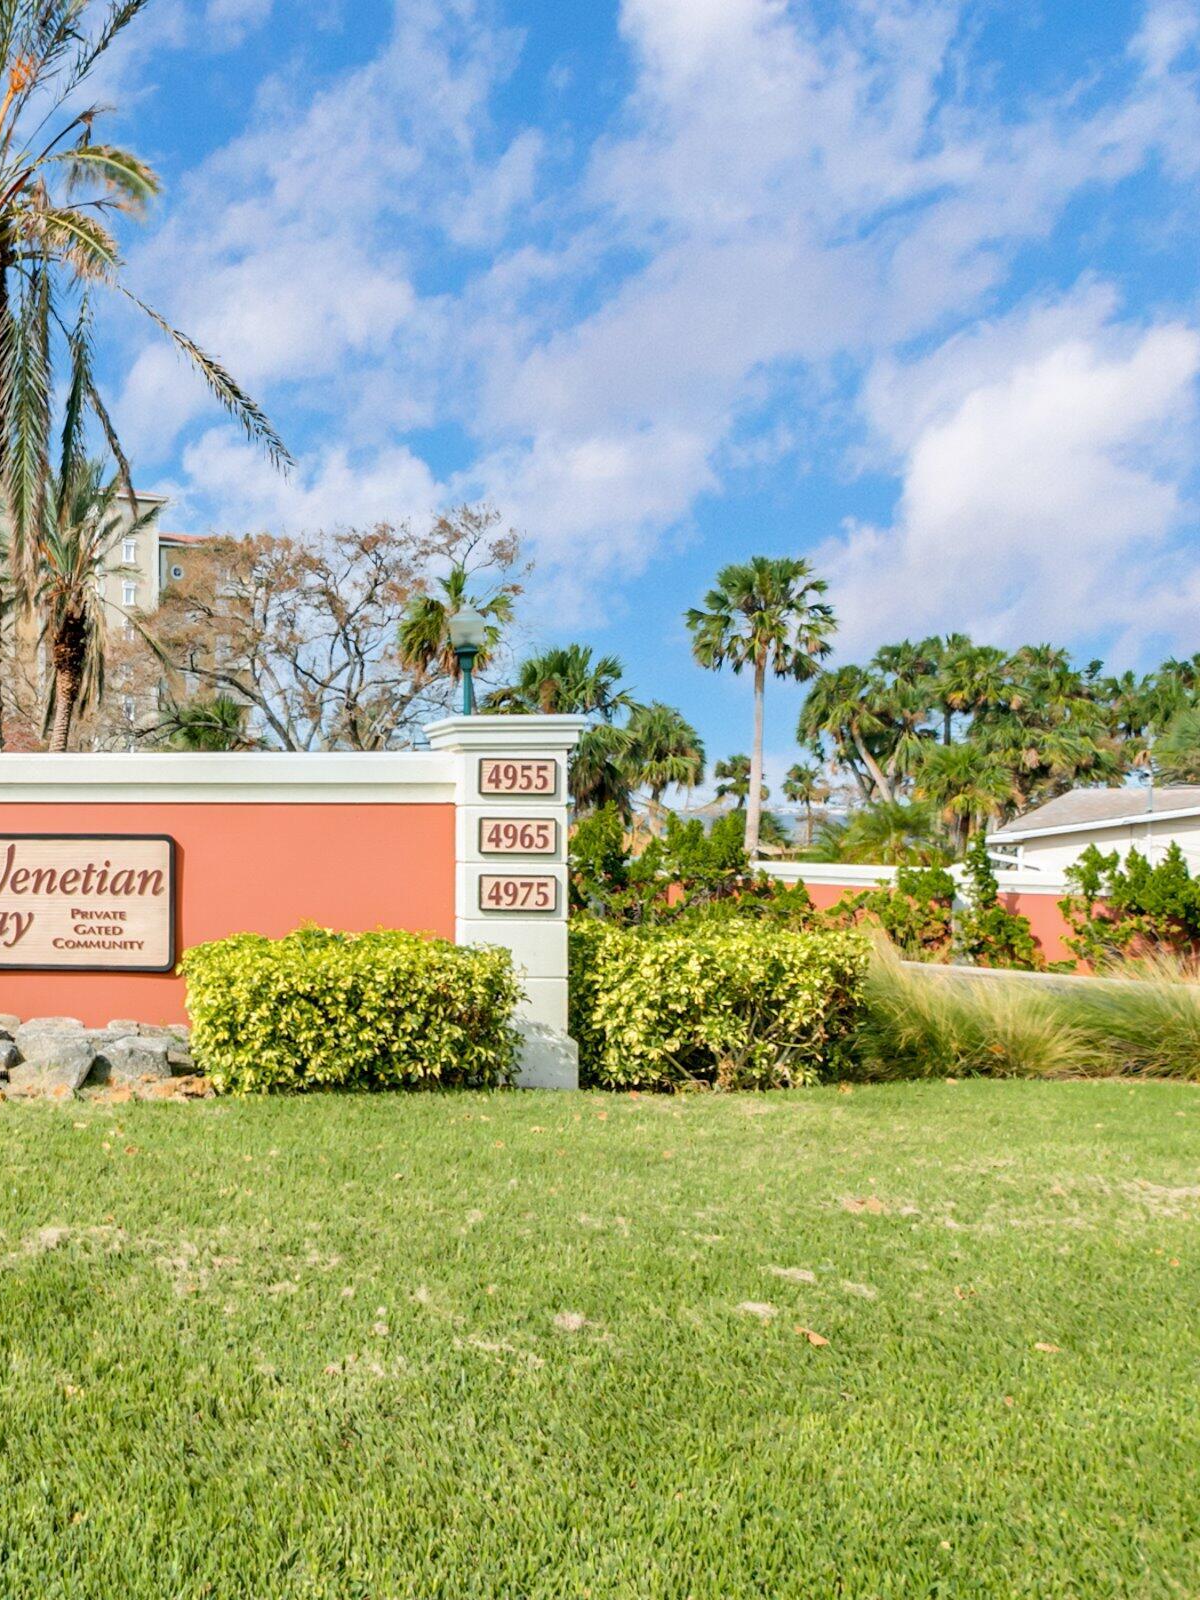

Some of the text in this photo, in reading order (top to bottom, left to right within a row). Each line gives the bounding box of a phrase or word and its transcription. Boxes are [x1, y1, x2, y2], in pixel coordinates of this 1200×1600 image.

[487, 764, 548, 790] 4955
[487, 823, 549, 849] 4965
[487, 881, 549, 906] 4975
[70, 908, 126, 921] PRIVATE
[73, 924, 123, 936] GATED
[52, 937, 144, 950] COMMUNITY
